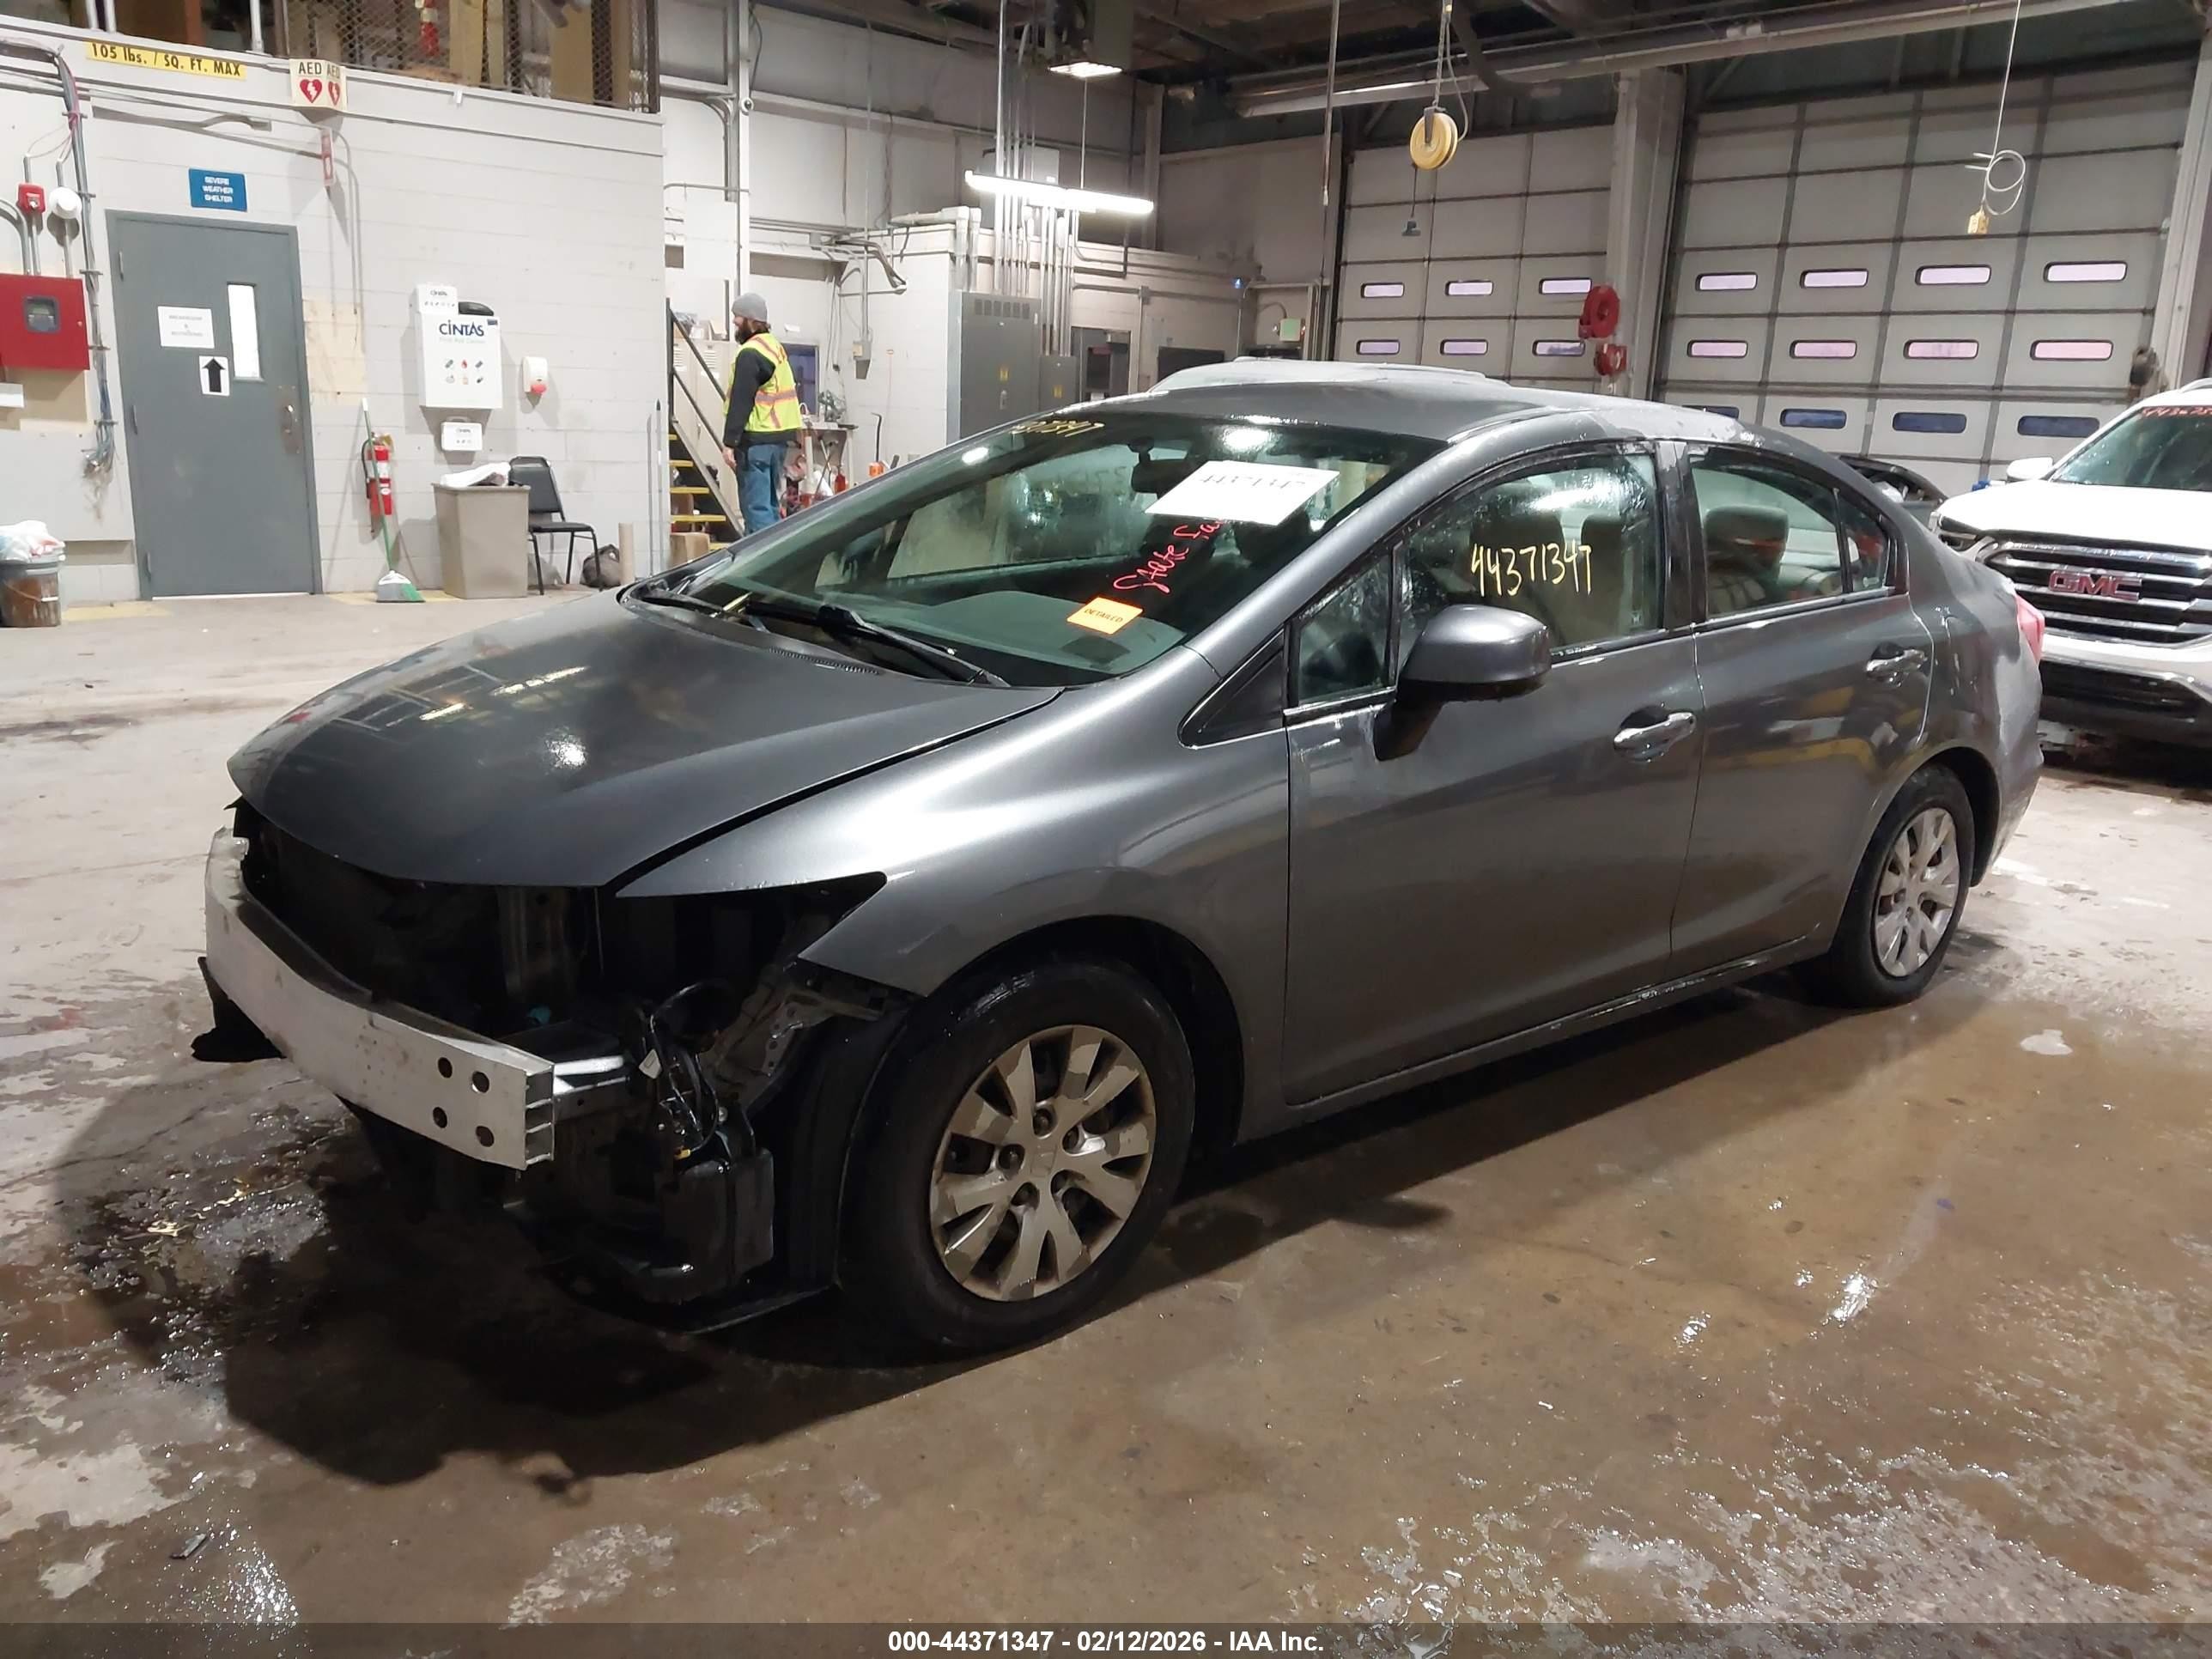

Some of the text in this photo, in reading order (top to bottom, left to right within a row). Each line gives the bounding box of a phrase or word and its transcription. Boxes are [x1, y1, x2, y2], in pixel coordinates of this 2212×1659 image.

[92, 43, 117, 59] 105
[124, 47, 148, 64] lbs.
[164, 54, 185, 70] SQ.
[190, 58, 208, 72] FT.
[214, 60, 241, 76] MAX
[299, 62, 322, 75] AED
[1471, 538, 1593, 597] 44371347
[2049, 570, 2142, 603] GMC
